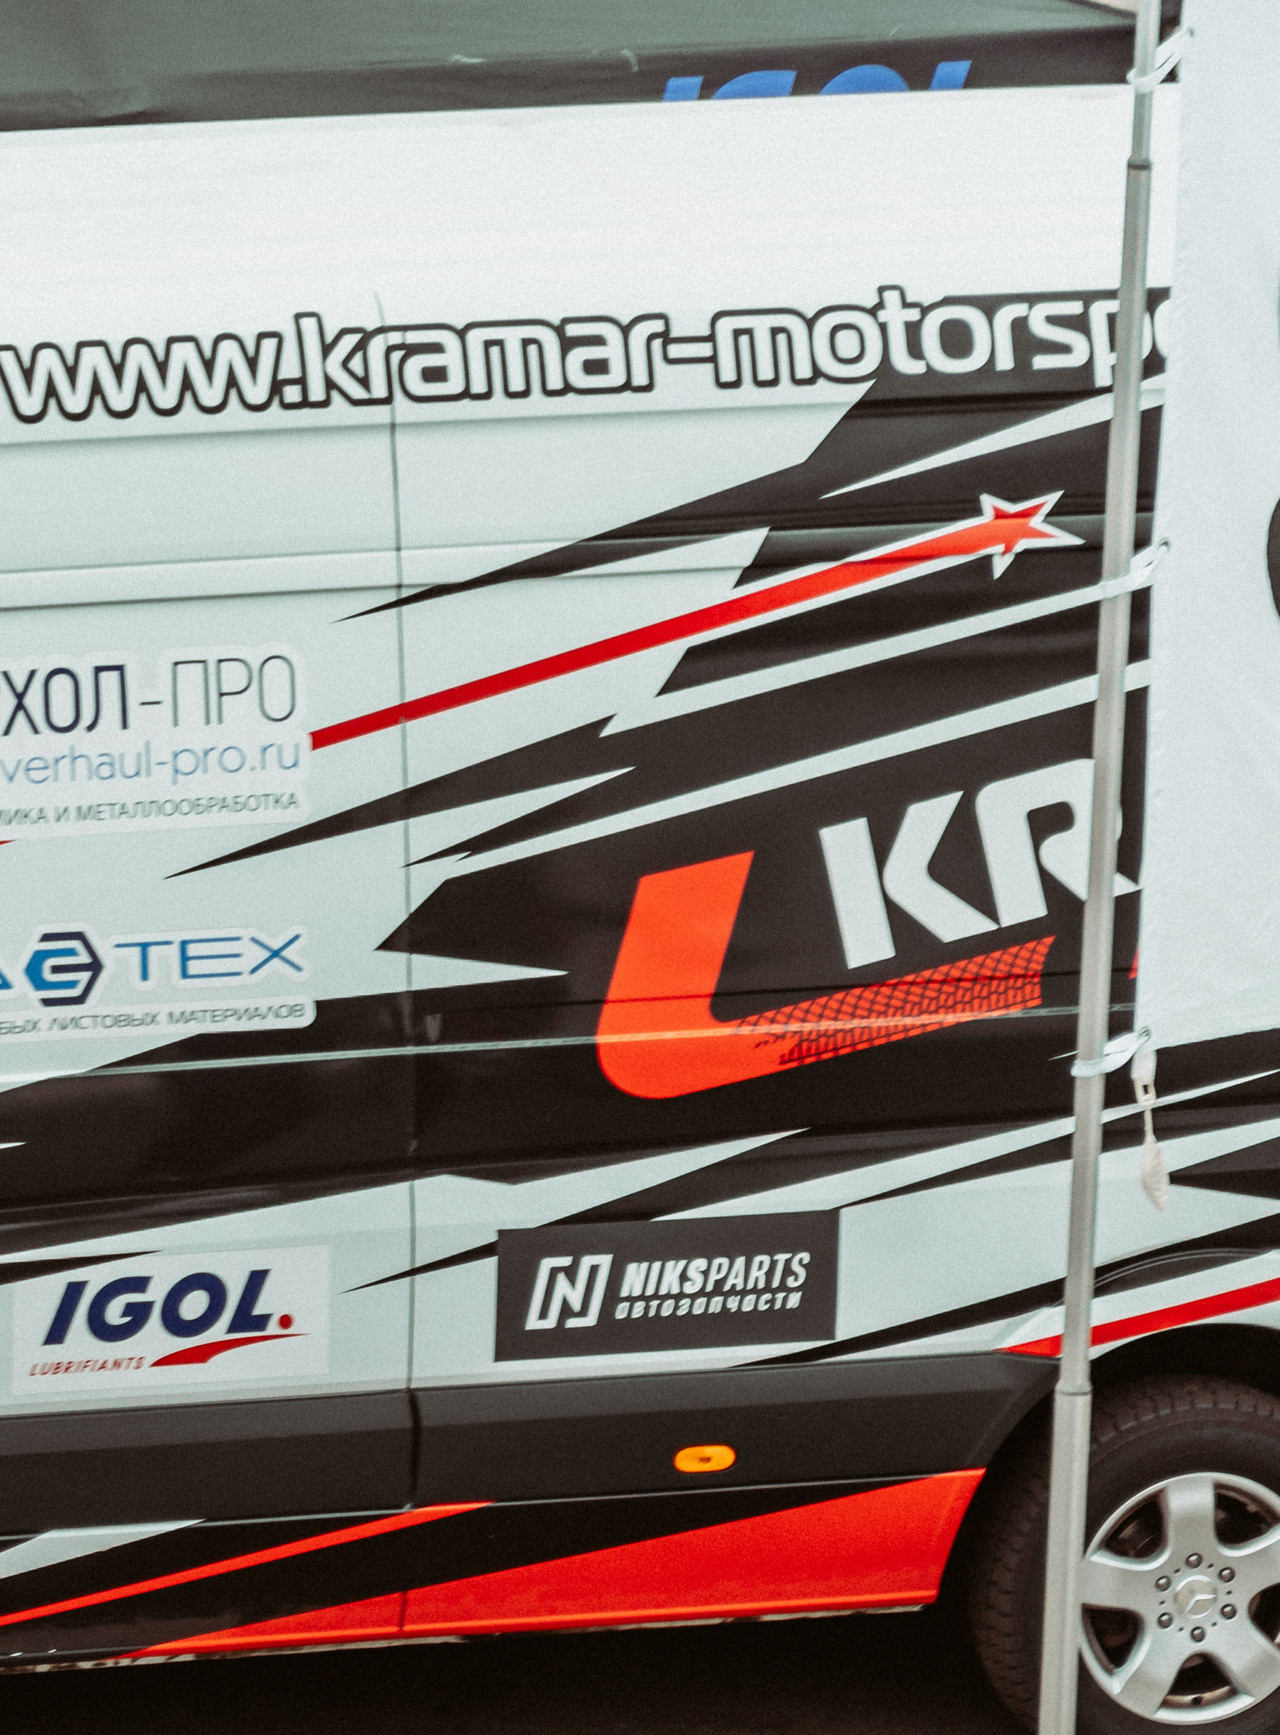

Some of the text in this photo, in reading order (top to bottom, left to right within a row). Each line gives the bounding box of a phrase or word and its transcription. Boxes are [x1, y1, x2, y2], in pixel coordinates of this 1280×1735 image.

[54, 805, 71, 824] И
[74, 792, 301, 823] МЕТАЛЛООБРАБОТКА
[46, 1011, 160, 1033] ЛИСТОВЫХ
[166, 1003, 306, 1027] МАТЕРИАЛОВ
[619, 1252, 812, 1298] NIKSPARTS
[28, 1356, 148, 1377] LUBRIFIANTS
